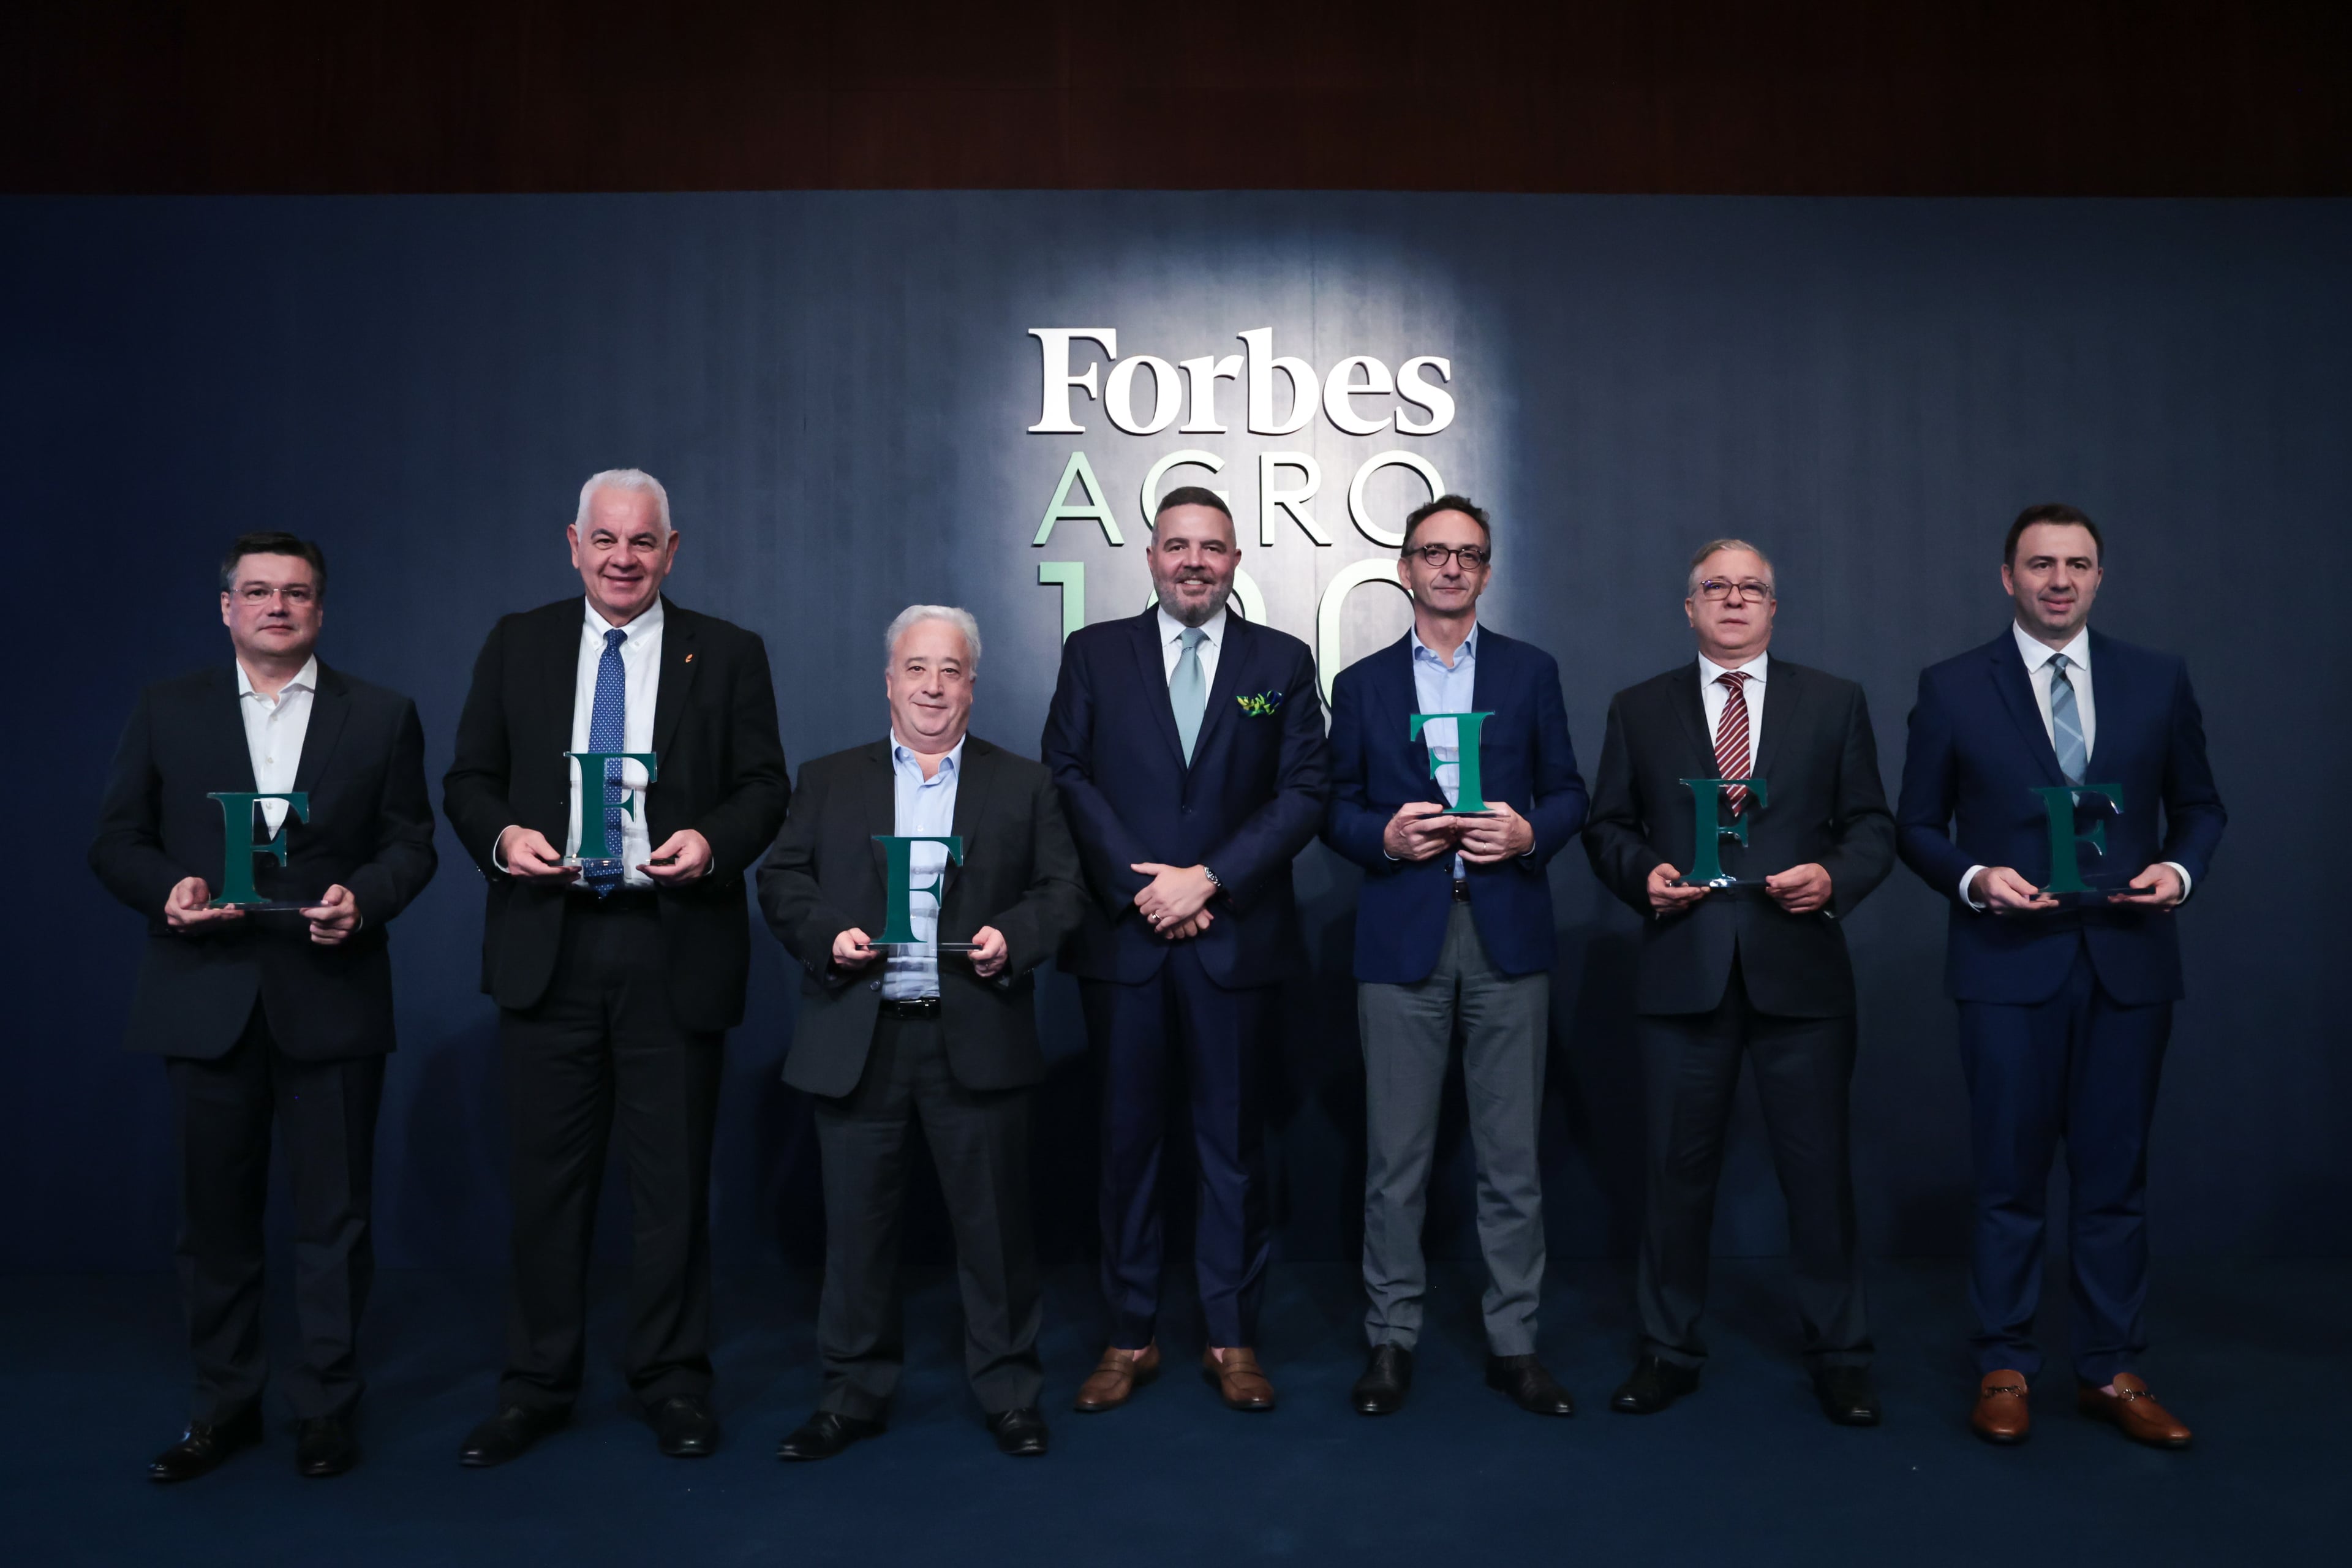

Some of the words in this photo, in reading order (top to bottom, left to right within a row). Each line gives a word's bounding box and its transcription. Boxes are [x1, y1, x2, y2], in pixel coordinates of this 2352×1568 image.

[1027, 326, 1455, 435] Forbes
[1038, 558, 1415, 715] 10
[206, 791, 309, 905] F
[564, 751, 658, 859] F
[1679, 778, 1768, 881] F
[2028, 783, 2125, 893] F
[871, 835, 963, 943] F
